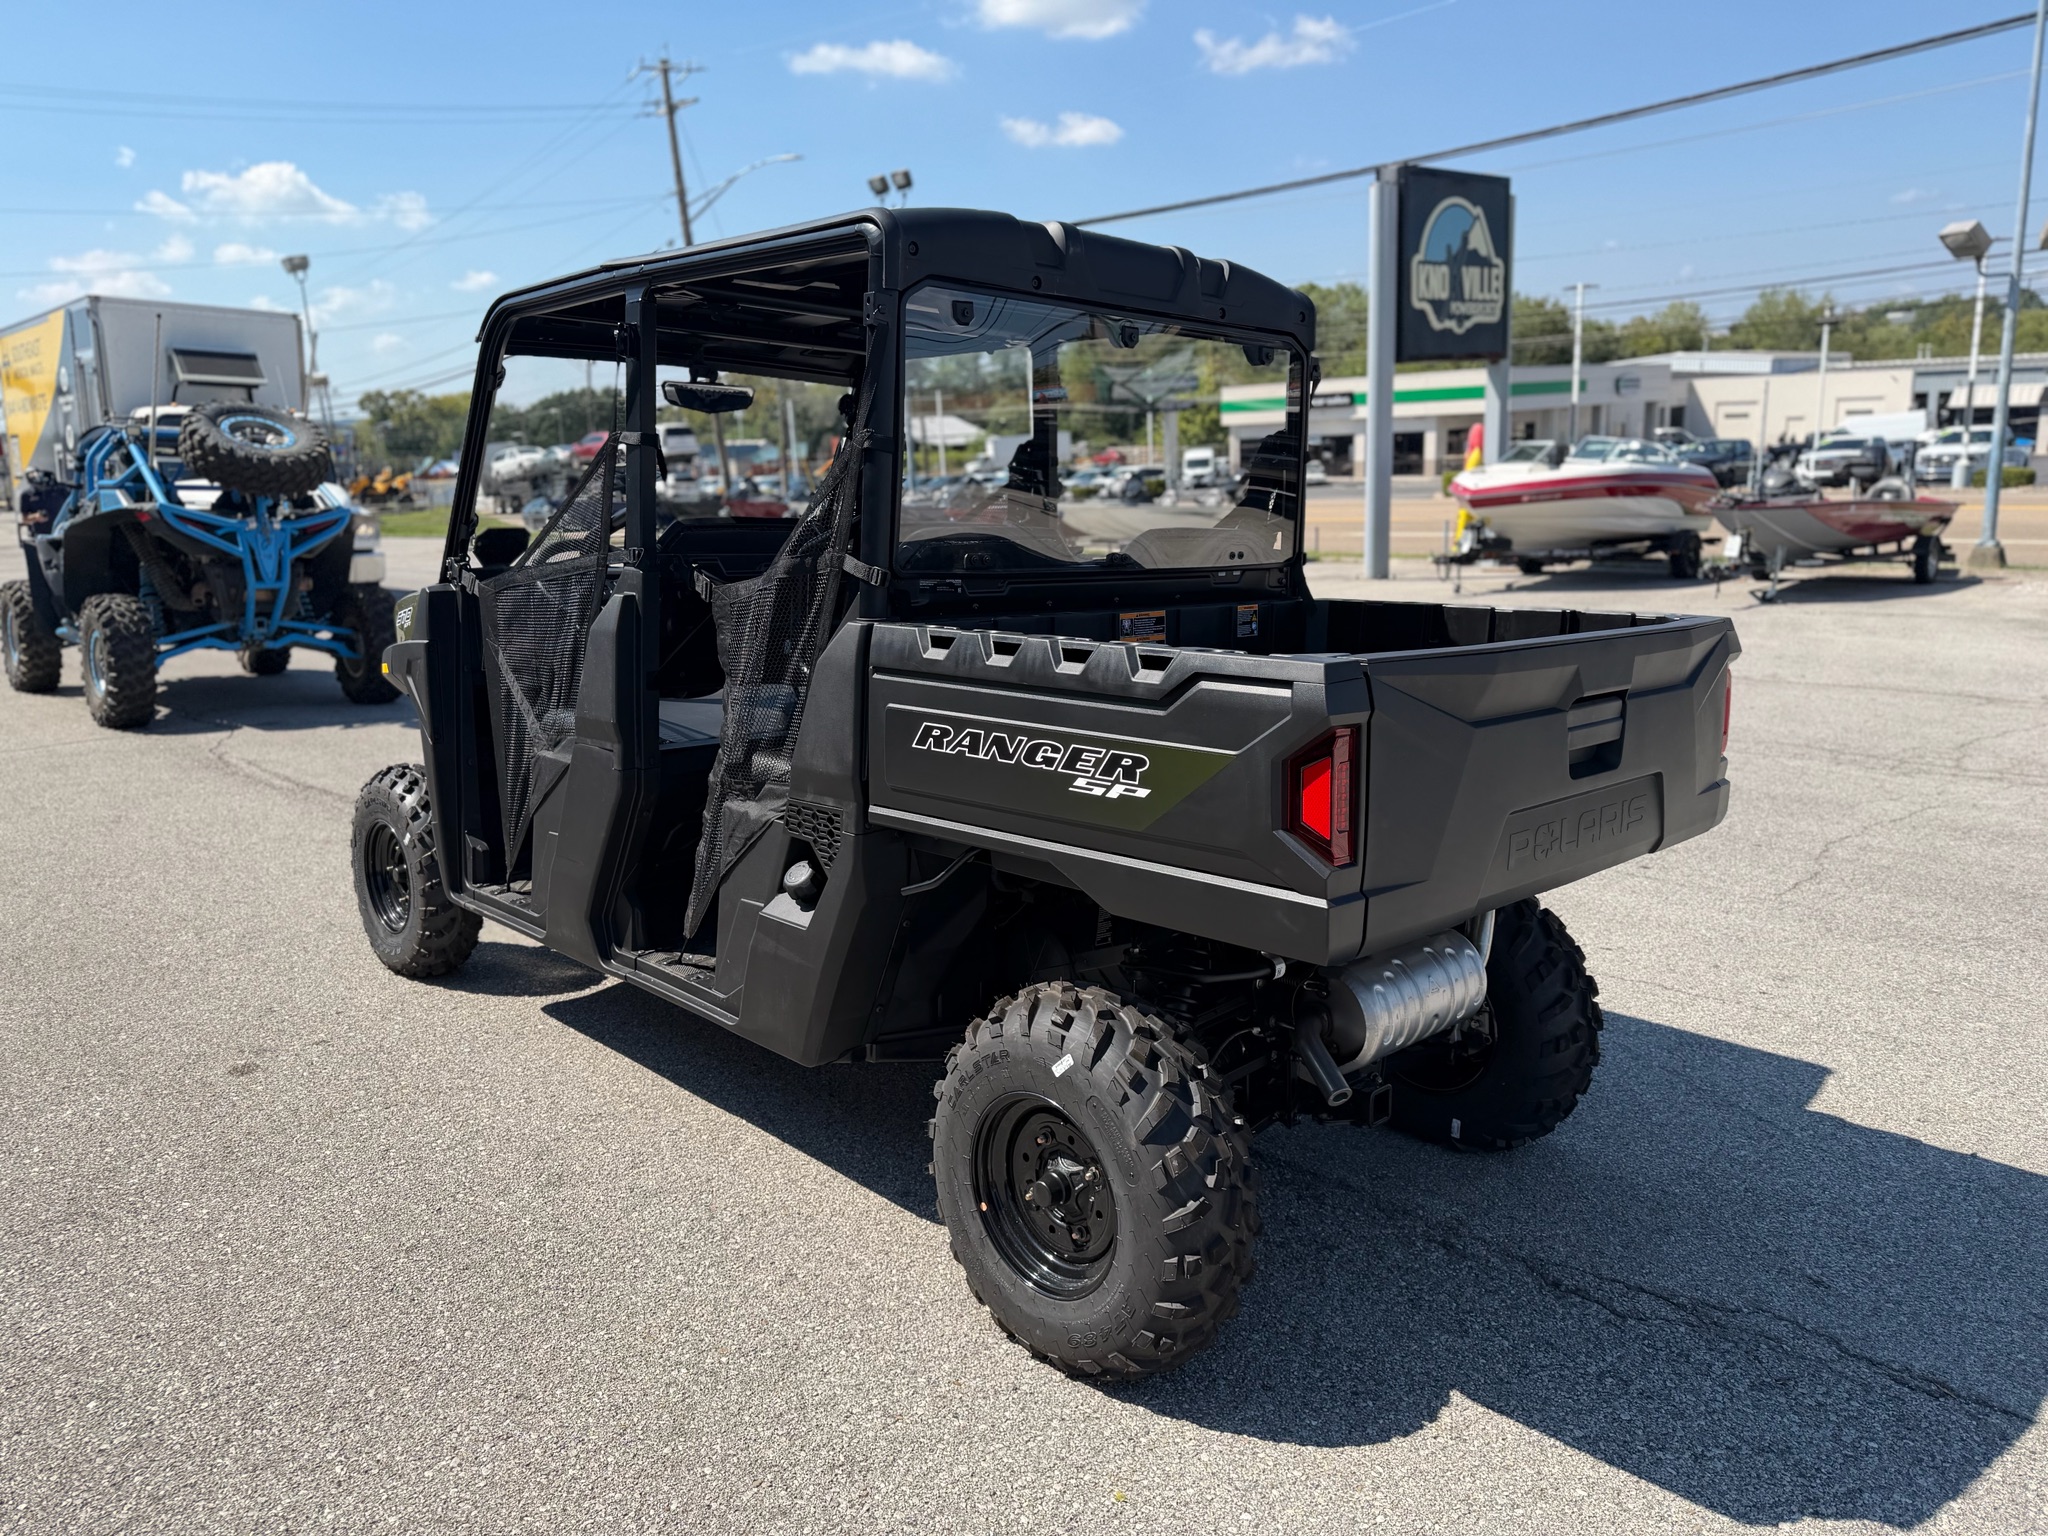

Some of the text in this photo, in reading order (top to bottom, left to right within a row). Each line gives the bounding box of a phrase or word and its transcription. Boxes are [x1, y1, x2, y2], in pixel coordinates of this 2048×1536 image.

[912, 722, 1150, 785] RANGER
[1068, 777, 1152, 799] SP
[1507, 794, 1647, 871] POLARIS
[947, 1049, 1011, 1110] CARLSTAR
